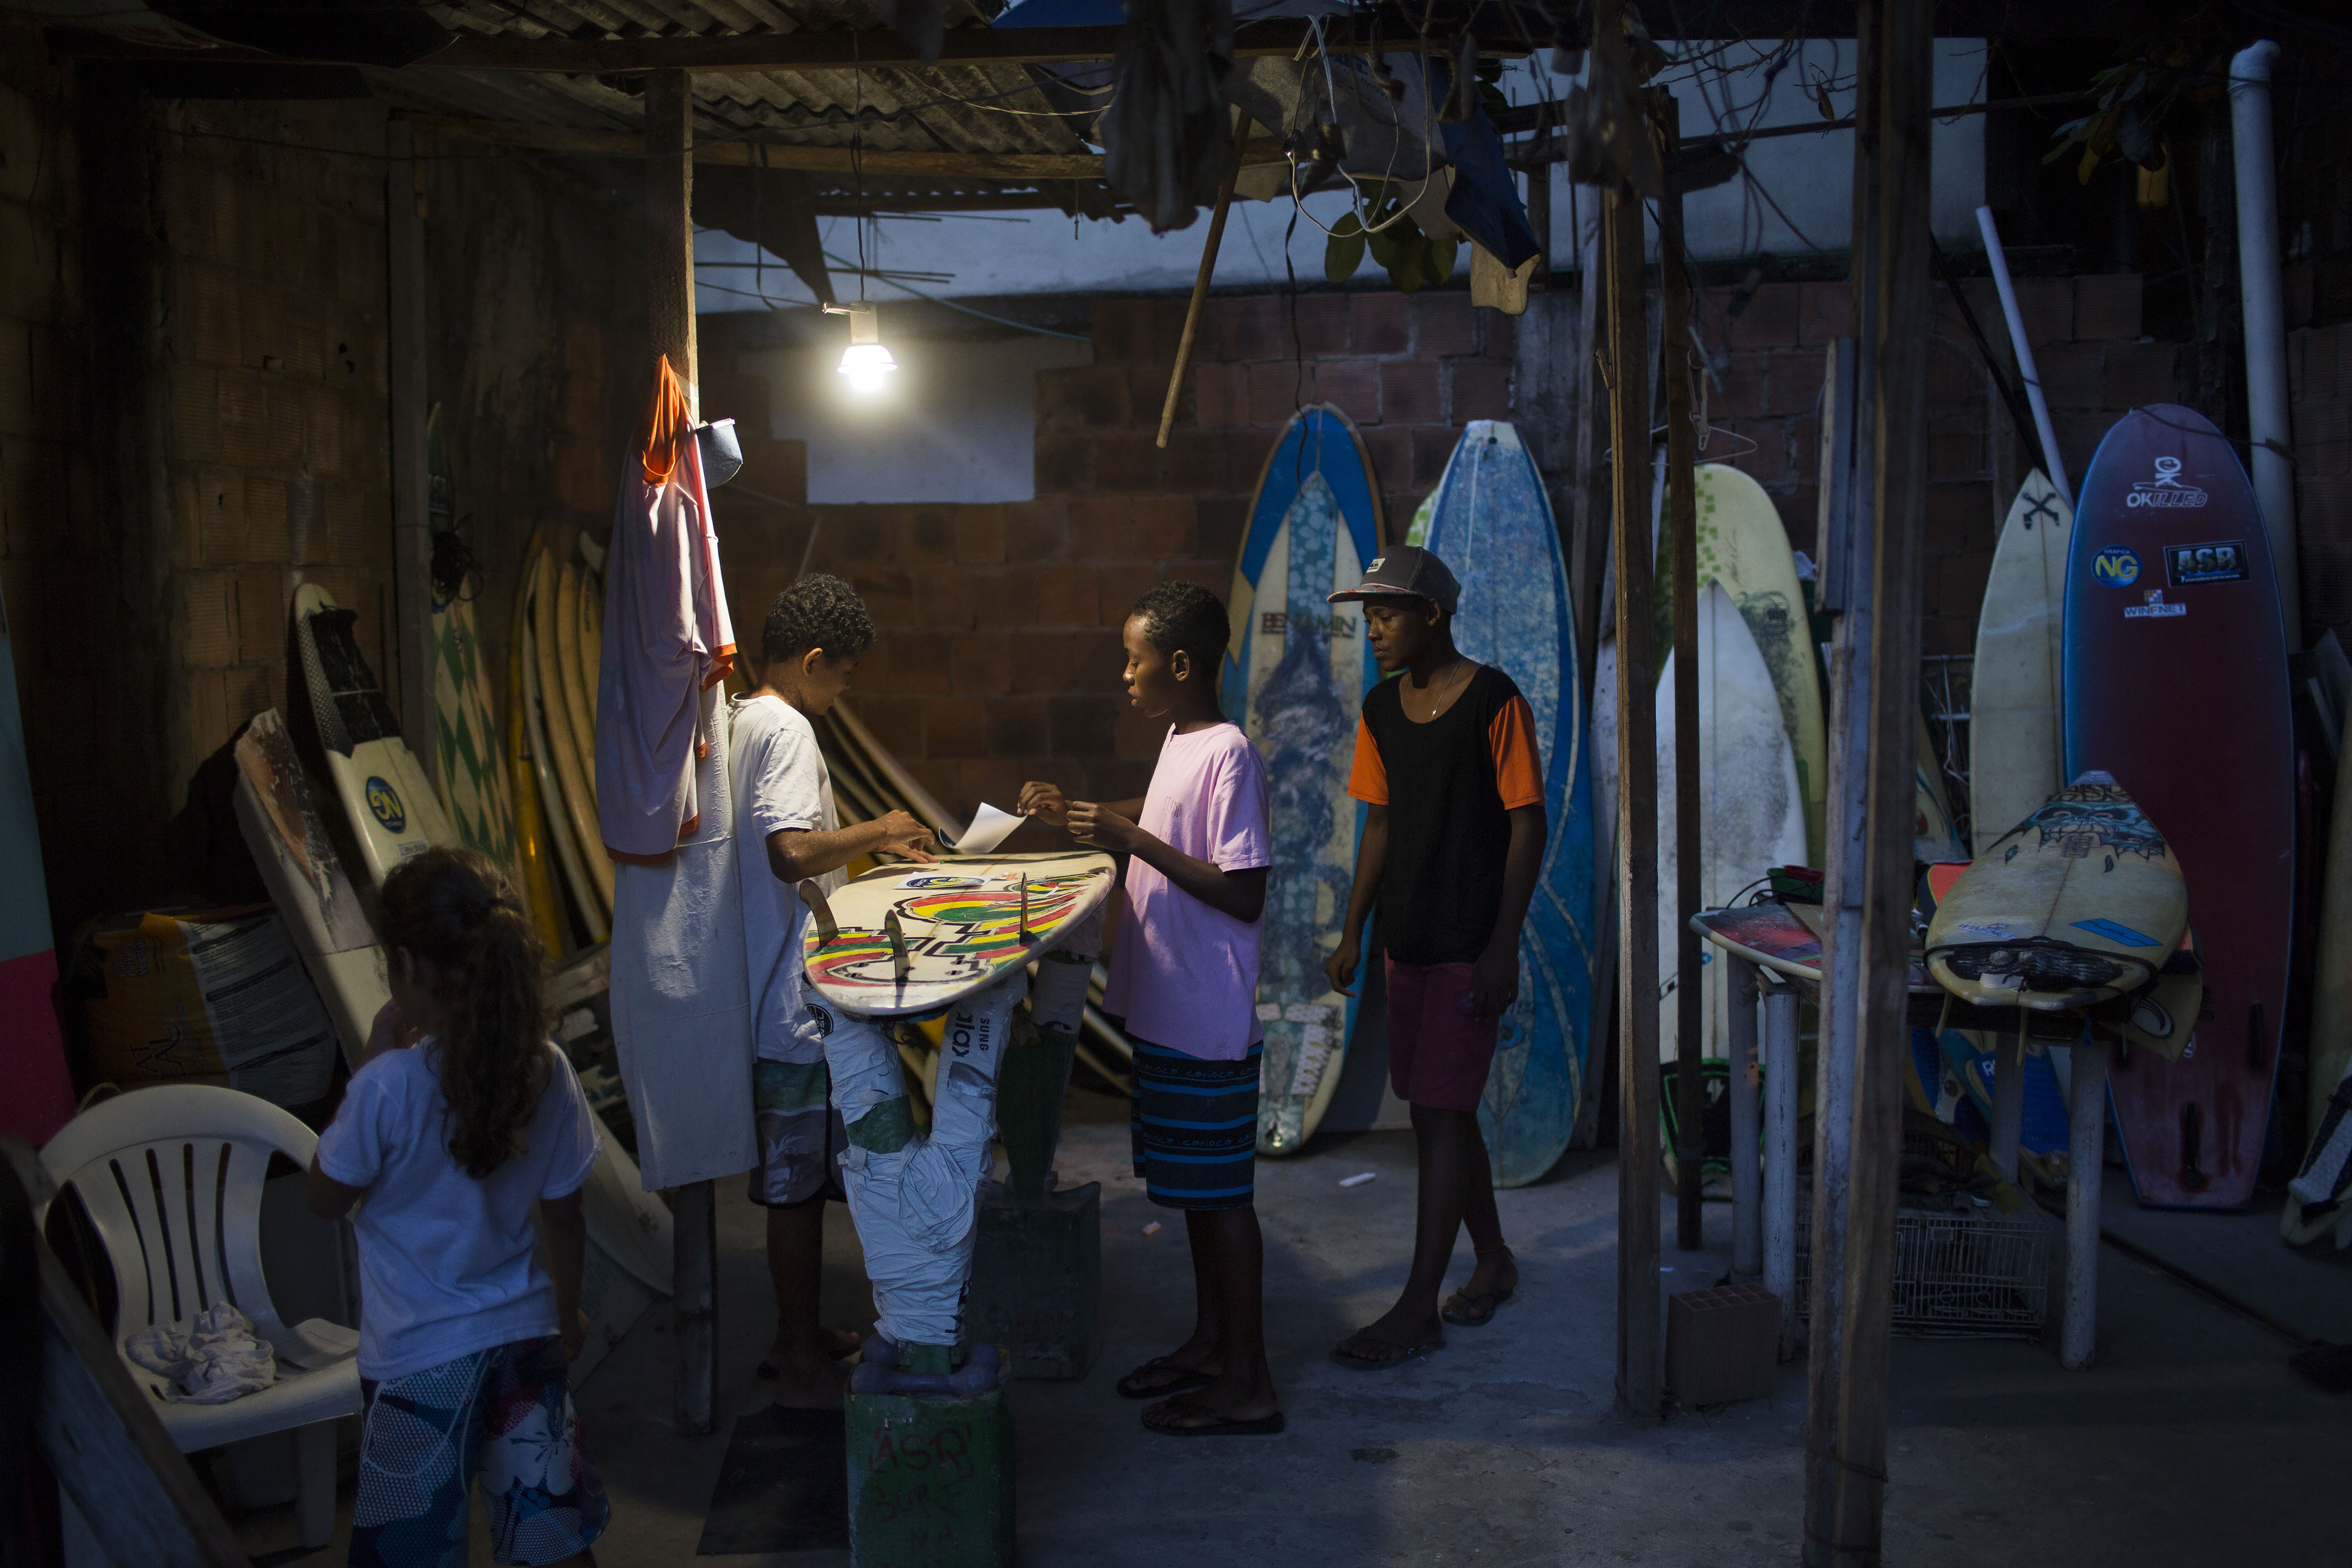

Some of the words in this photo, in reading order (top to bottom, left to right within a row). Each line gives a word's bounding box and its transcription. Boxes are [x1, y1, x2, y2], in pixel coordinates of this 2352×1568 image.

[2126, 492, 2208, 508] OKILLED
[2096, 554, 2139, 579] NG
[369, 790, 402, 819] NG
